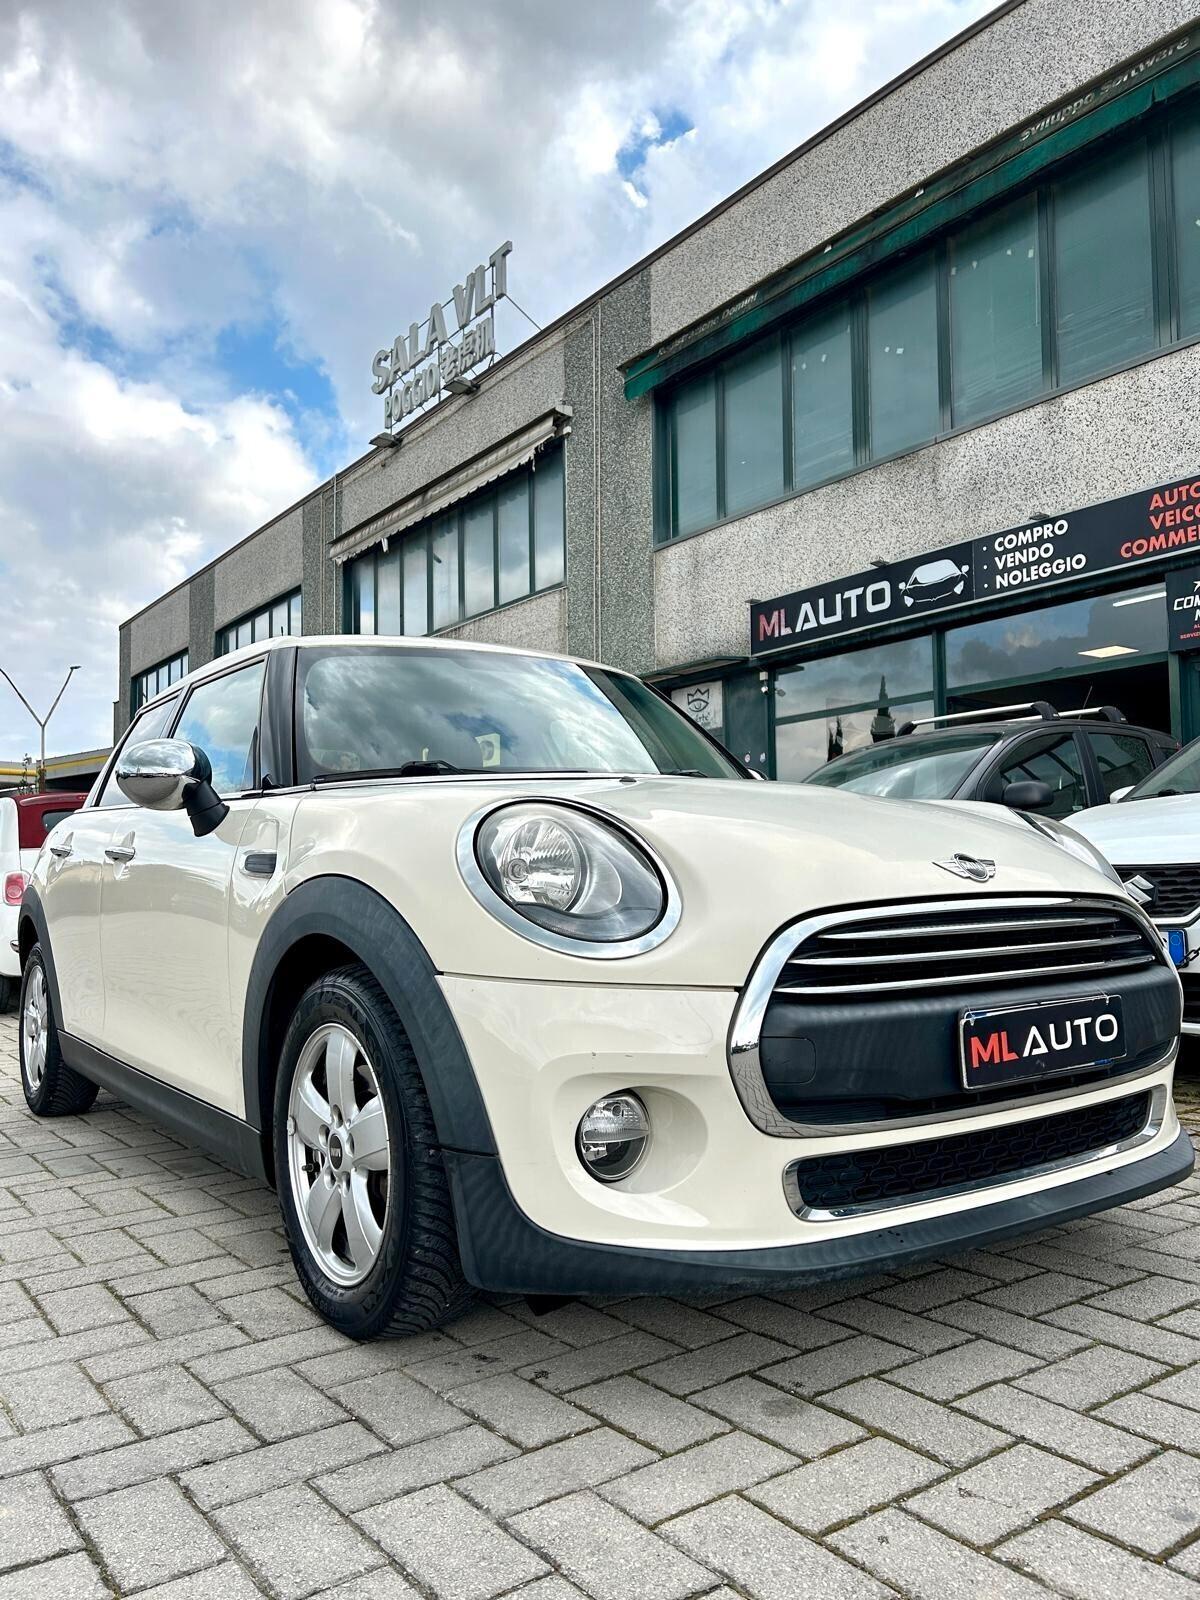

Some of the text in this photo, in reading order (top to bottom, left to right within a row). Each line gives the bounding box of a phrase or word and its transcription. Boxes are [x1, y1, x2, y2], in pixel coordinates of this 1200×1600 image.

[371, 240, 513, 395] SALA VLT
[384, 362, 440, 429] POGGIO
[994, 519, 1069, 552] COMPRO
[994, 542, 1055, 571] VENDO
[995, 553, 1087, 590] NOLEGGIO
[795, 580, 892, 633] AUTO
[1022, 1013, 1119, 1058] AUTO
